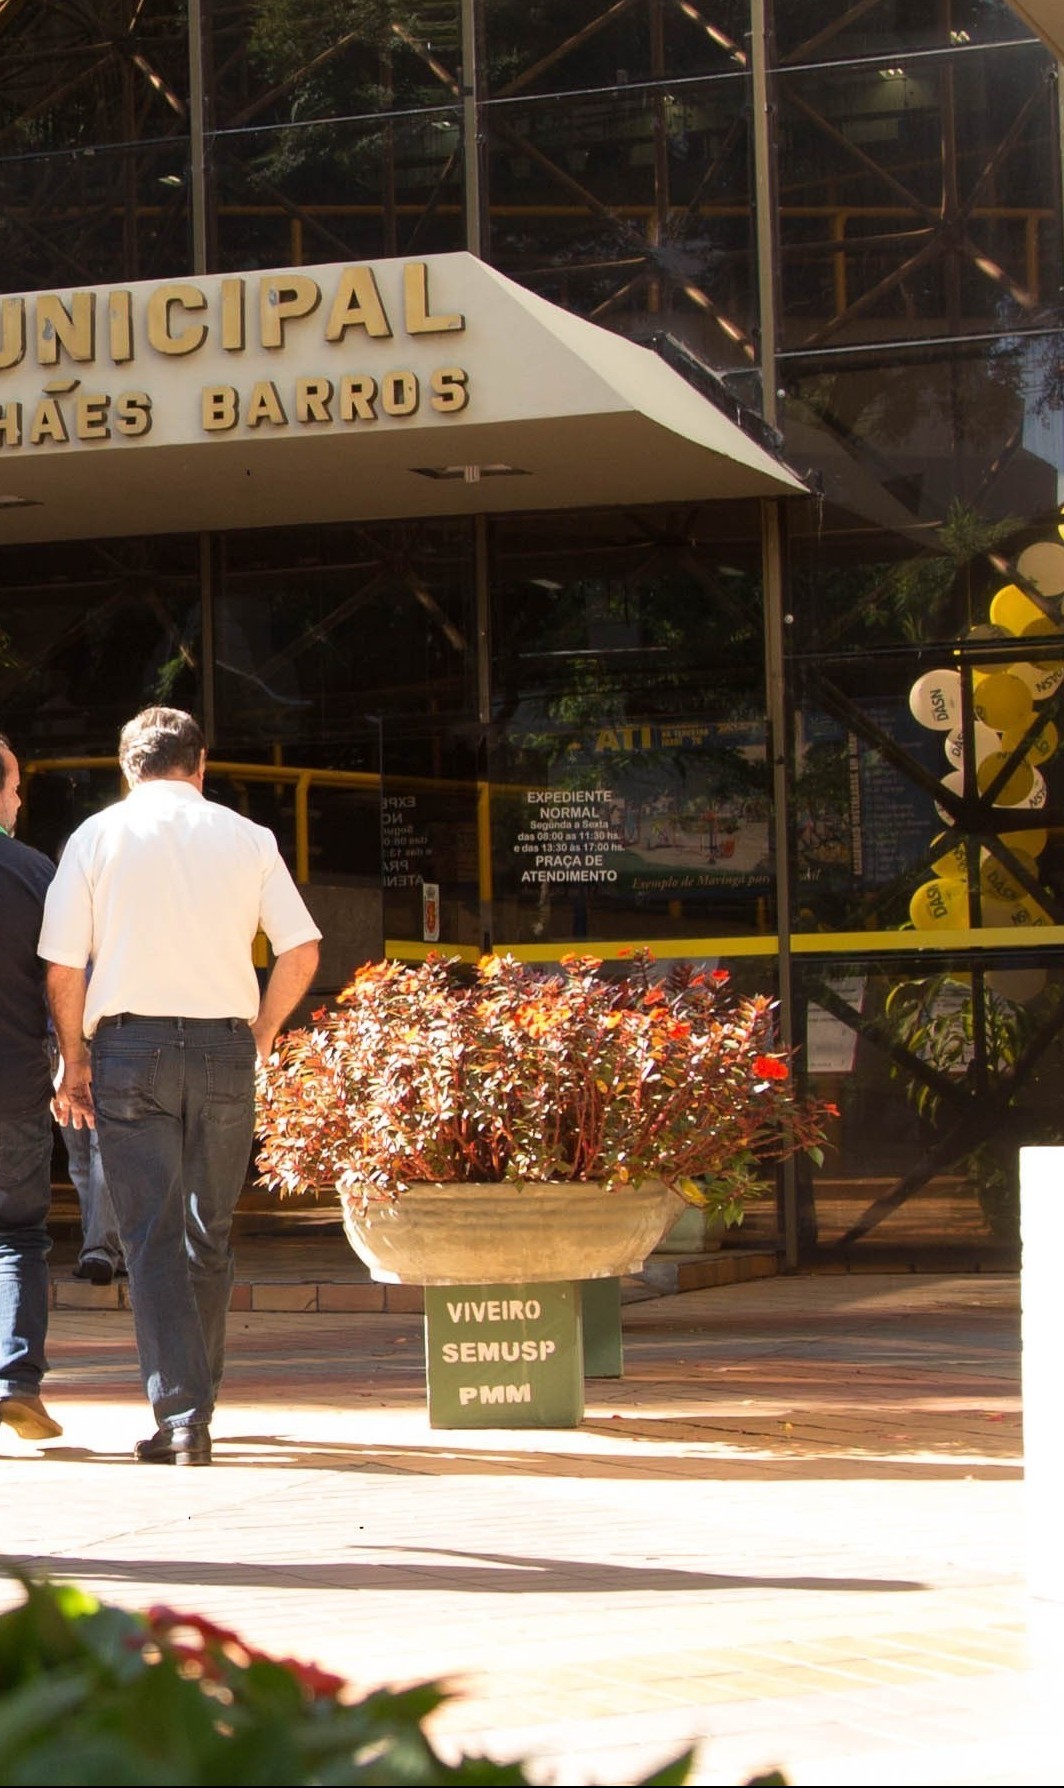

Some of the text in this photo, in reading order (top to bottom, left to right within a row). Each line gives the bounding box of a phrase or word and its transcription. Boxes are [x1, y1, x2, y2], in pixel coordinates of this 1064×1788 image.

[201, 367, 469, 433] BARROS
[929, 688, 949, 721] DASN
[527, 790, 613, 803] EXPEDIENTE
[539, 807, 600, 819] NORMAL
[582, 819, 609, 829] Sexta
[517, 832, 535, 841] das
[537, 831, 563, 841] 08:00
[579, 831, 605, 840] 11:30
[521, 843, 539, 852] das
[542, 843, 568, 852] 13:30
[584, 842, 609, 852] 17:00
[536, 854, 603, 869] PRAÇA DE
[521, 870, 618, 882] ATENDIMENTO
[446, 1300, 541, 1324] VIVEIRO
[441, 1340, 556, 1364] SEMUSP
[458, 1383, 532, 1406] PMM
